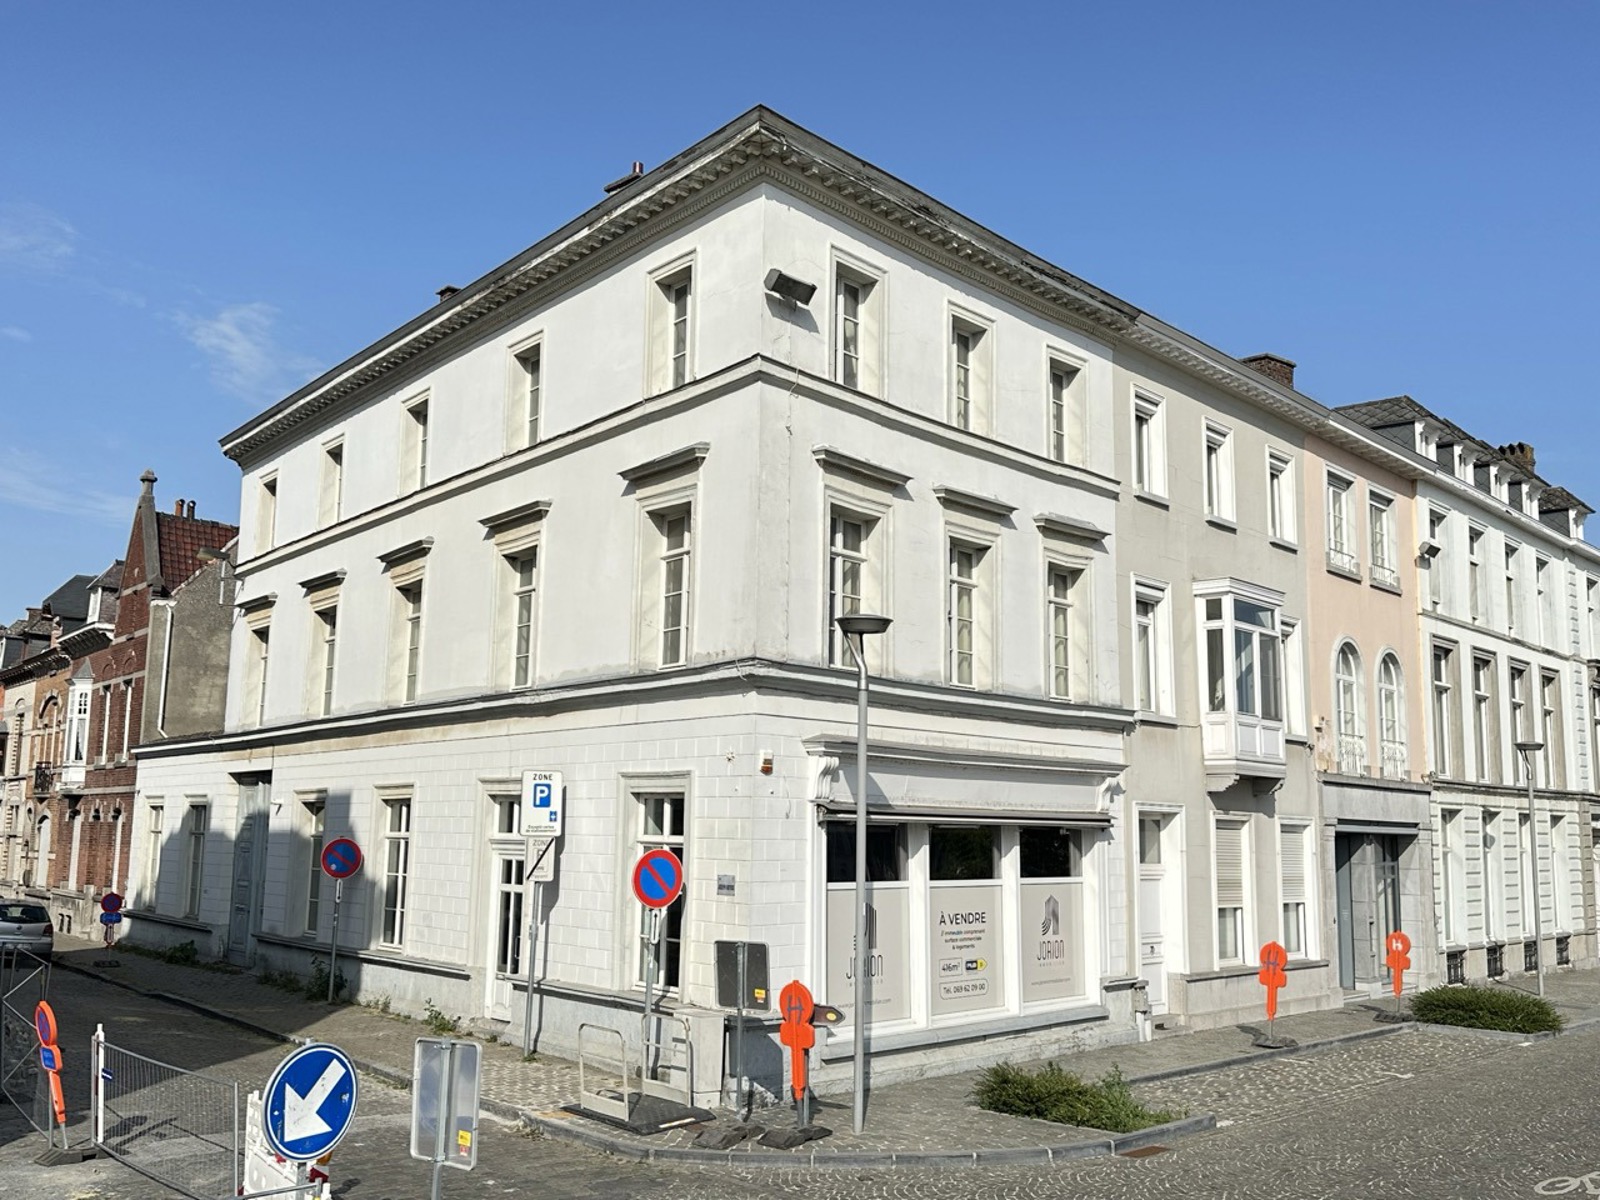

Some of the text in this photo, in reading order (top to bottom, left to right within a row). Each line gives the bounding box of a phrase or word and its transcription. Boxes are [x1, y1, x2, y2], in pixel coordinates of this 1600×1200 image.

[536, 786, 550, 806] P
[940, 910, 986, 926] À VENDRE
